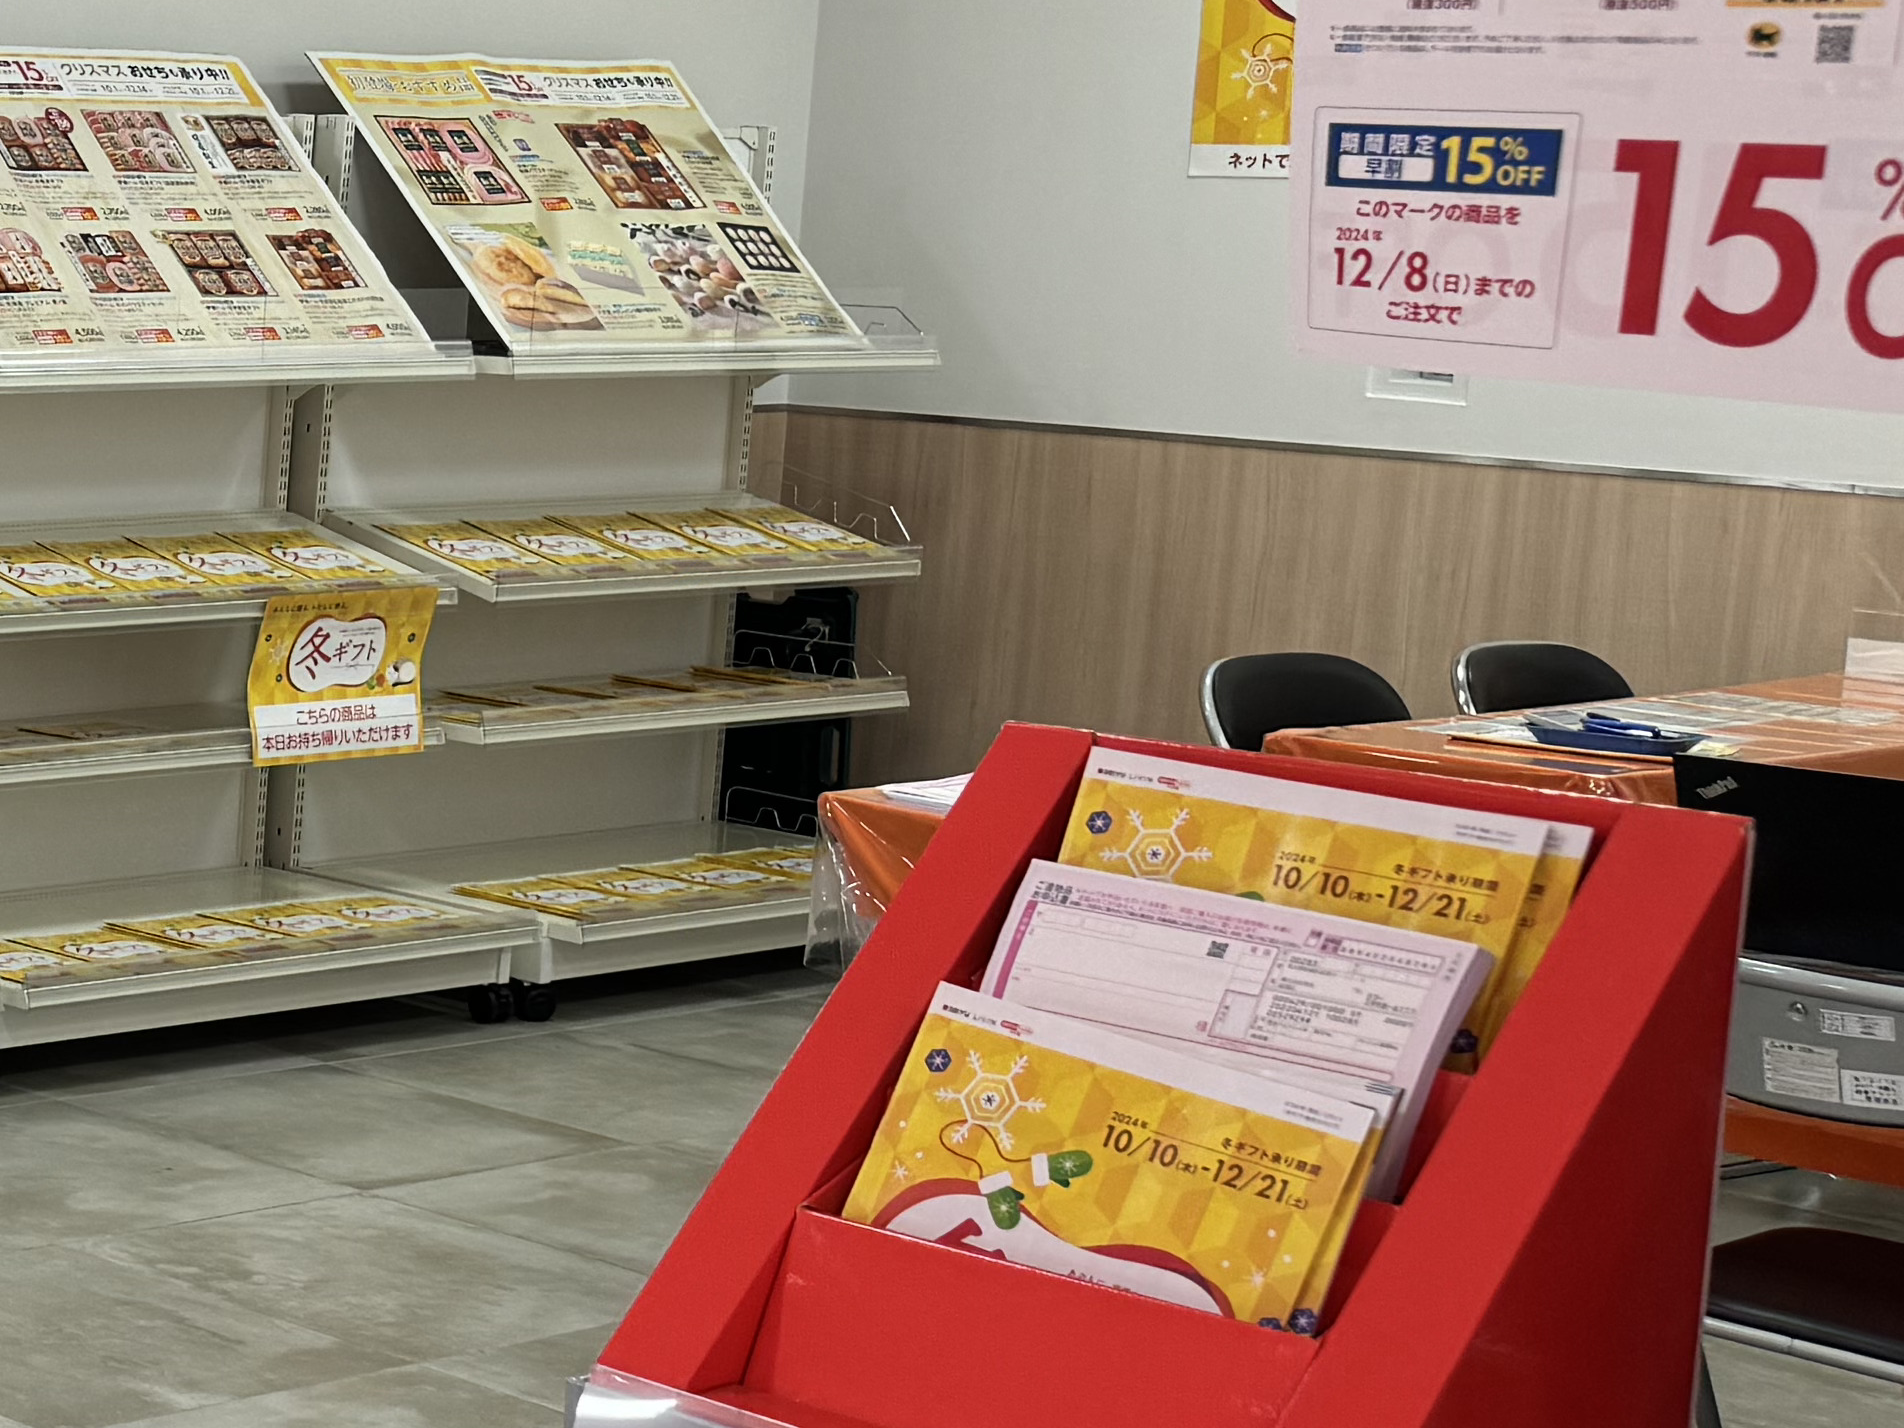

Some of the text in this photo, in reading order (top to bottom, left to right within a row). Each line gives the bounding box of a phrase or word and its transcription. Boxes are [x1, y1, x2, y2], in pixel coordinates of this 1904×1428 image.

[1339, 132, 1435, 156] 期間限定
[1356, 201, 1522, 226] このマークの商品を
[1385, 302, 1463, 325] ご注文で
[295, 625, 378, 681] 冬ギフト
[296, 704, 377, 727] こちらの商品は
[262, 723, 414, 753] 本日お持ち帰りいただけます
[1110, 1111, 1149, 1131] 2024年
